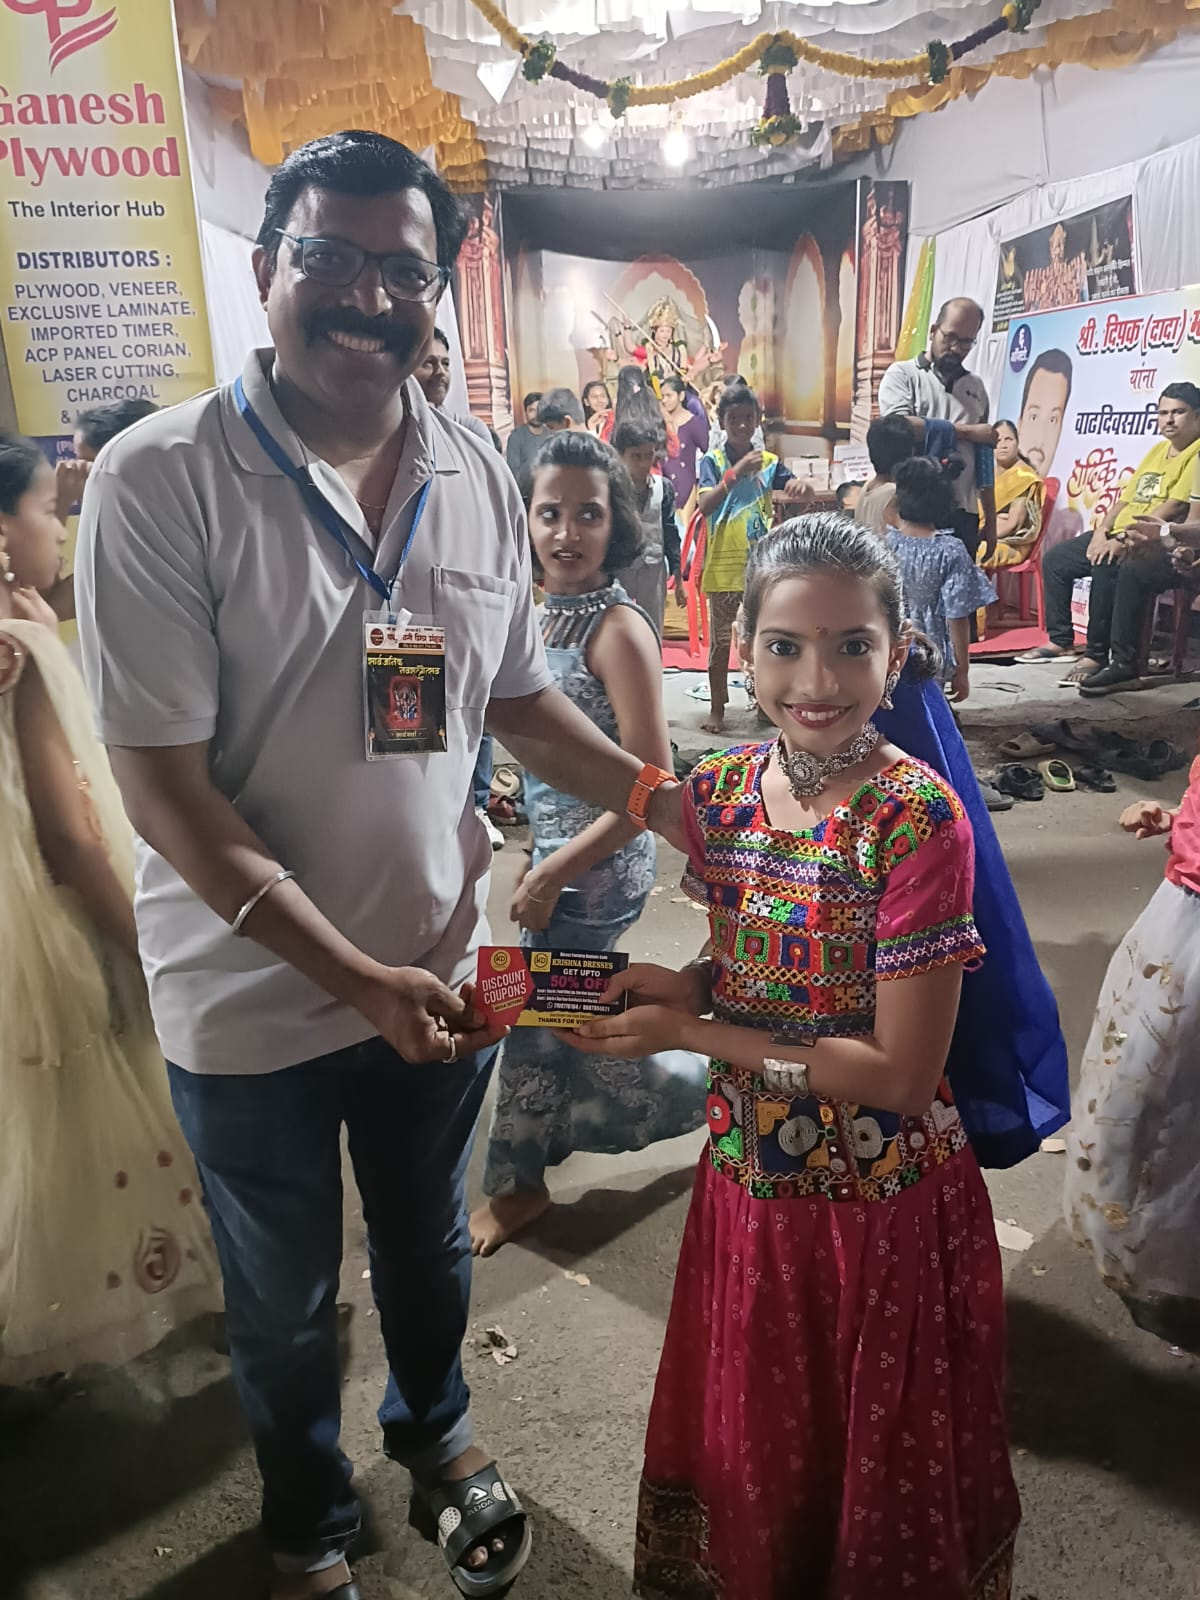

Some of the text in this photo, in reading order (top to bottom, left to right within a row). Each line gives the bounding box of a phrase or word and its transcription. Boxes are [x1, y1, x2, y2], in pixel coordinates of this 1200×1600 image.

[8, 201, 165, 217] The Interior Hub
[17, 250, 160, 269] DISTRIBUTORS
[15, 281, 183, 299] PLYWOOD, VENEER,
[8, 302, 196, 321] EXCLUSIVE LAMINATE,
[31, 323, 179, 341] IMPORTED TIMER,
[1104, 314, 1144, 348] दिपक
[25, 343, 192, 363] ACP PANEL CORIAN,
[42, 364, 180, 383] LASER CUTTING,
[1130, 361, 1157, 389] यांना
[67, 384, 160, 402] CHARCOAL
[61, 410, 72, 424] &
[1075, 402, 1160, 435] वाढदिवसानि
[1067, 447, 1118, 498] हार्दिक
[552, 959, 613, 969] KRISHNA DRESSES
[563, 968, 600, 977] GET UPTO
[482, 969, 526, 992] DISCOUNT
[550, 975, 580, 989] 50%
[484, 983, 527, 1004] COUPONS
